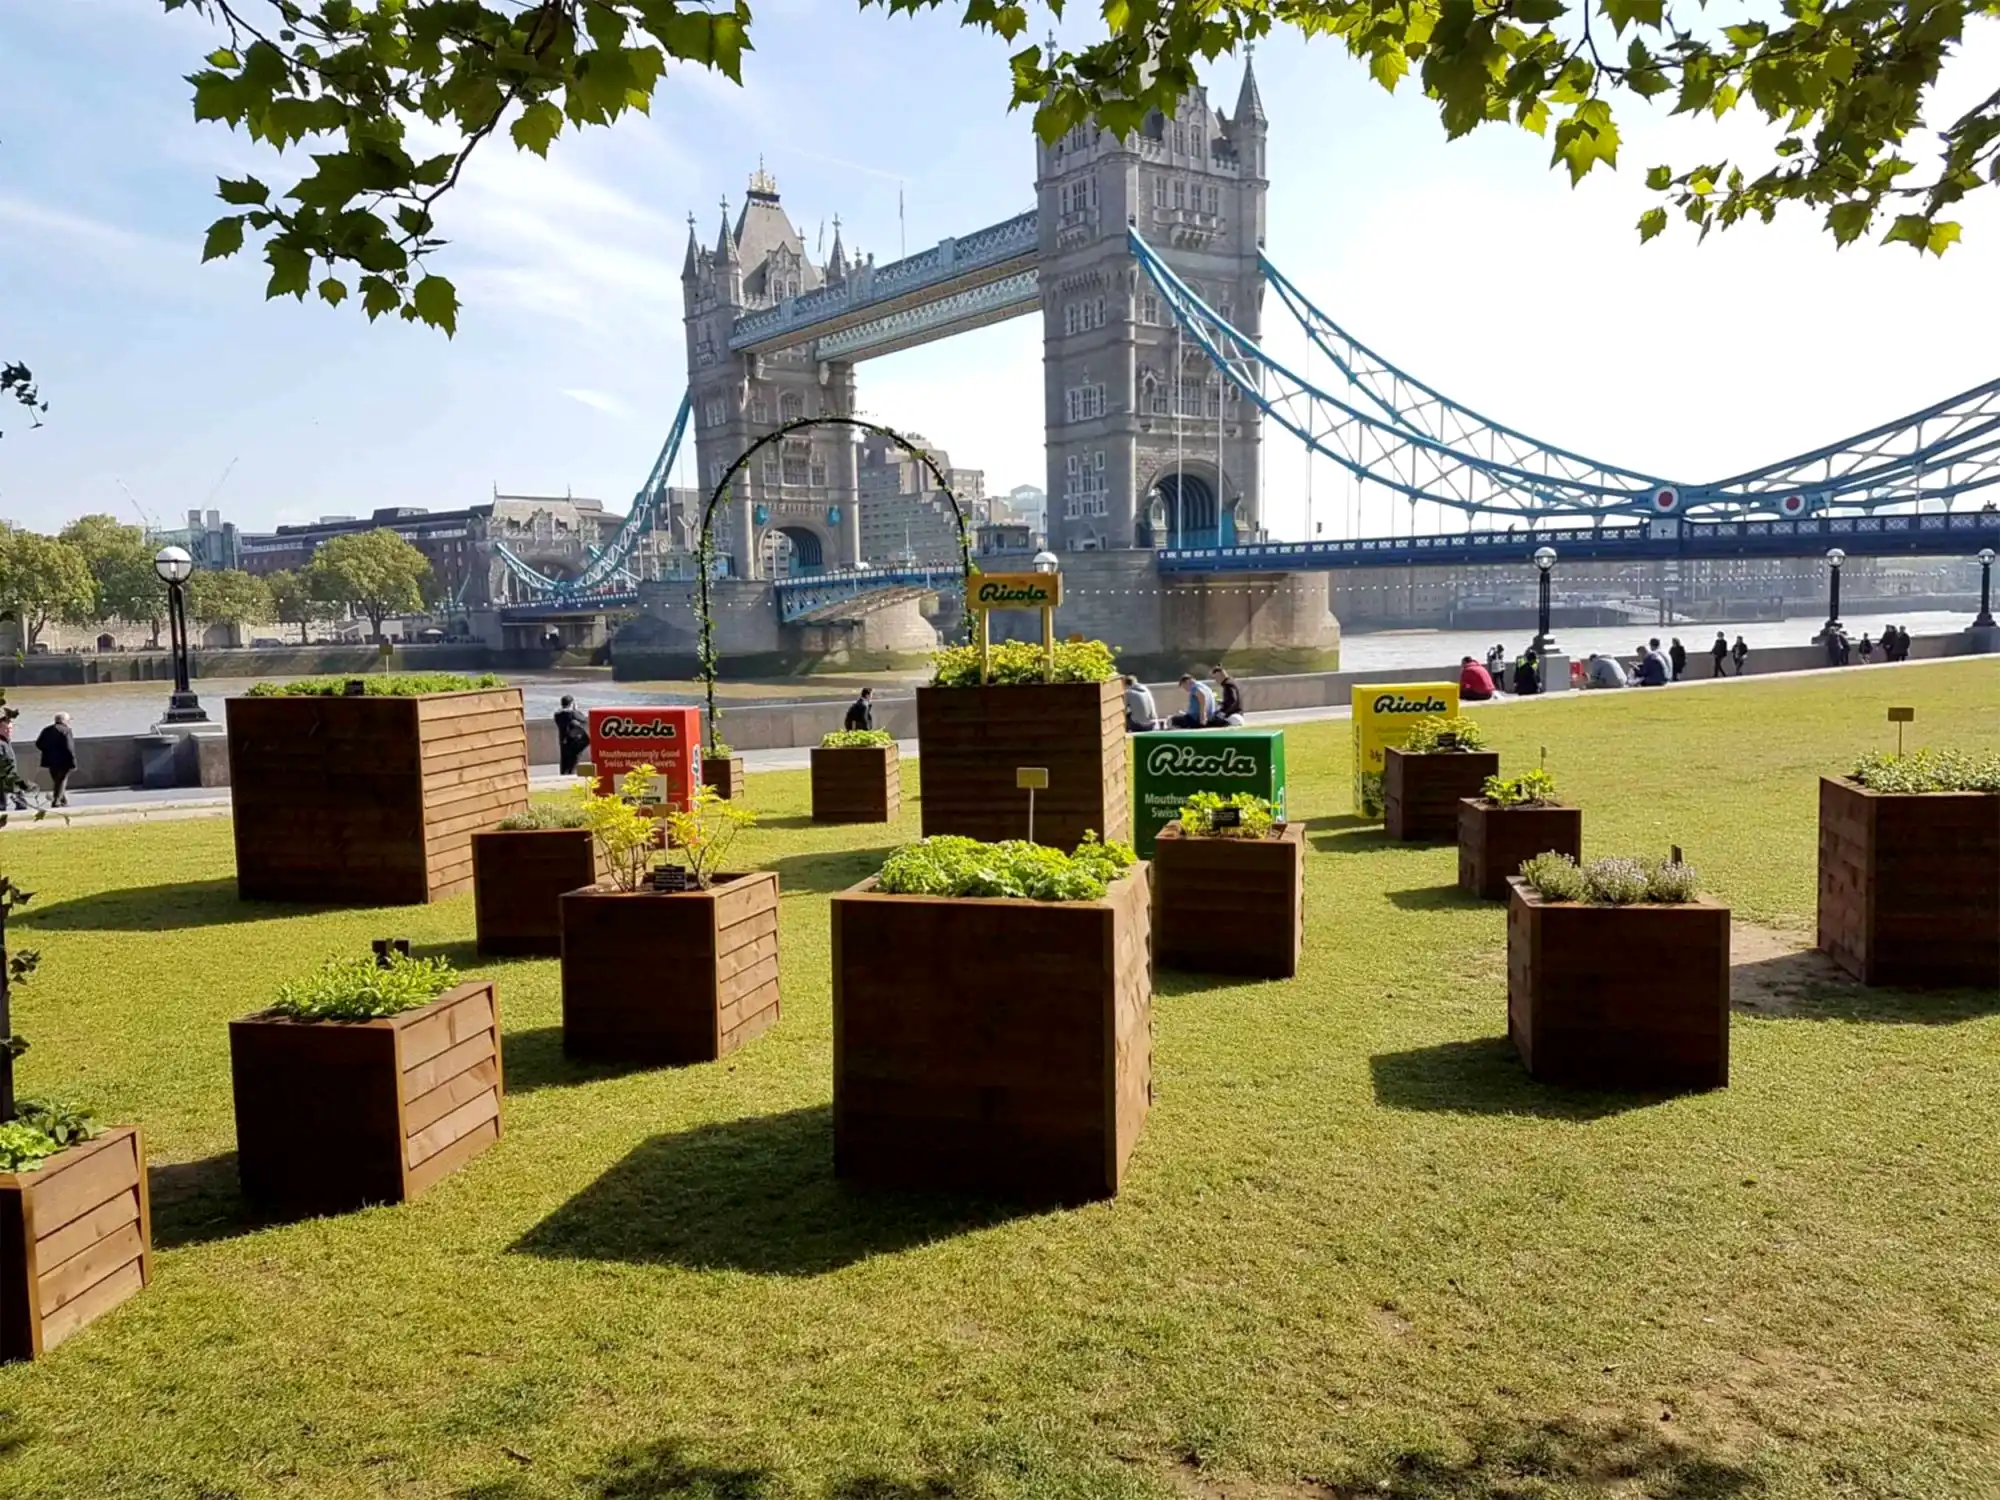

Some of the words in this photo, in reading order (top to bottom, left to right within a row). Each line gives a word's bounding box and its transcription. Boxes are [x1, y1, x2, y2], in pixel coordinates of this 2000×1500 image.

[979, 583, 1049, 602] Ricola
[1373, 695, 1447, 713] Ricola
[601, 716, 677, 739] Ricola
[1147, 743, 1257, 776] Ricola
[1151, 806, 1179, 818] Swiss
